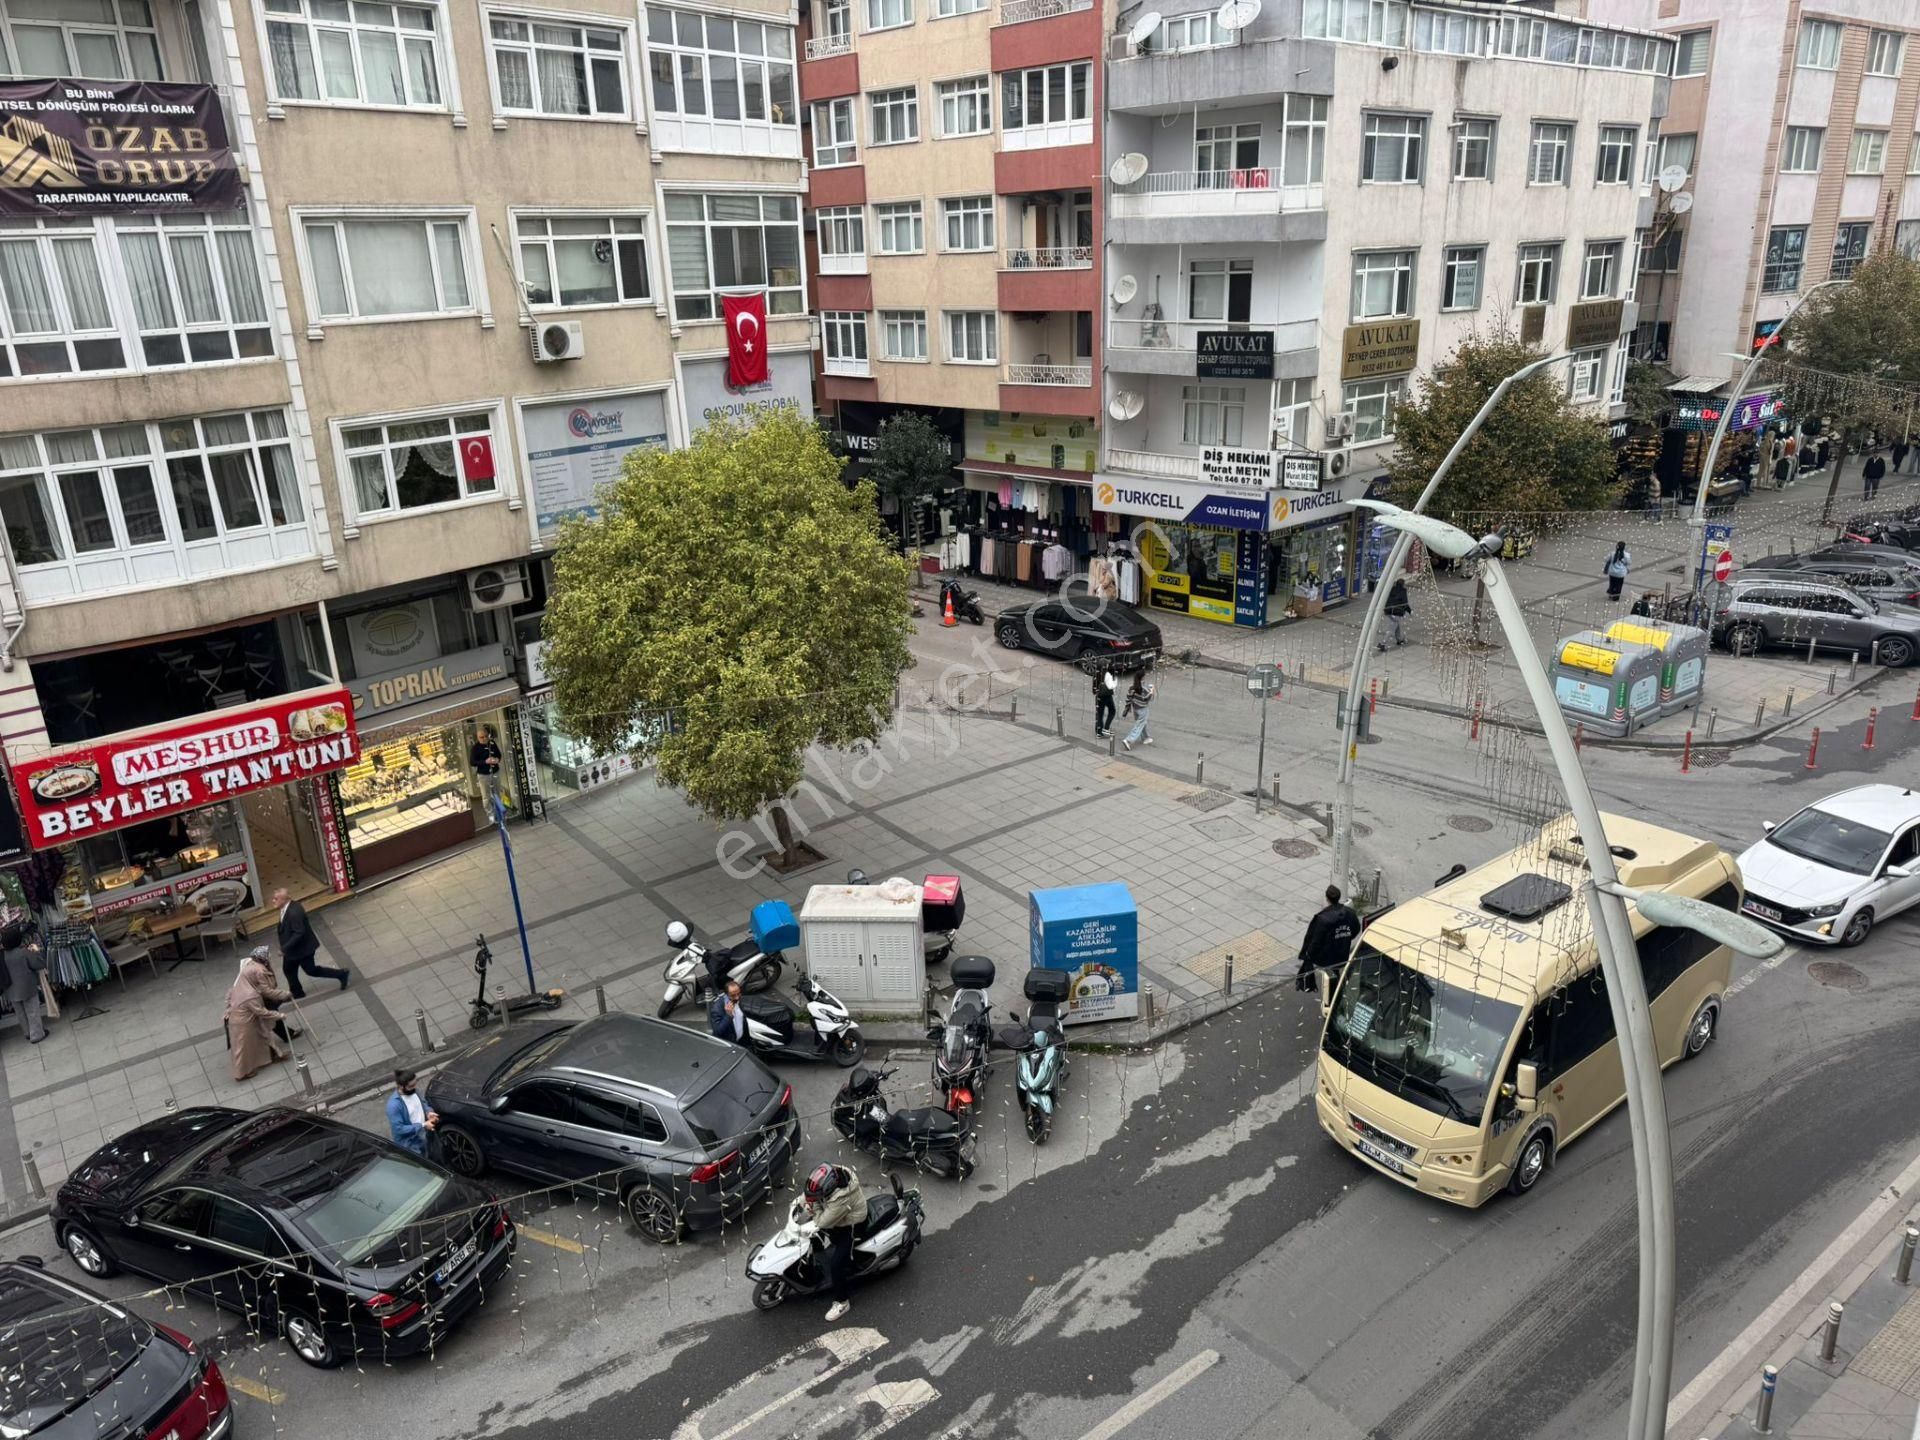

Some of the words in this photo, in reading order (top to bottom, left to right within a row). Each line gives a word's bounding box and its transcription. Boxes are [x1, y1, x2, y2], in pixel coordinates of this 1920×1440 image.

[66, 88, 84, 99] BU
[87, 88, 115, 99] BİNA
[37, 99, 100, 113] DÖNÜŞÜM
[102, 102, 149, 113] PROJESİ
[151, 104, 196, 114] OLARAK
[84, 118, 210, 152] ÖZAB
[95, 159, 216, 185] GRUP
[36, 193, 111, 204] TARAFINDAN
[113, 192, 192, 203] YAPILACAKTIR.
[1203, 335, 1267, 351] AVUKAT
[1357, 324, 1412, 347] AVUKAT
[1204, 448, 1223, 464] DİŞ
[1228, 451, 1270, 465] HEKİMİ
[1203, 463, 1232, 474] Murat
[1236, 465, 1270, 477] METİN
[1225, 475, 1239, 483] 546
[1116, 489, 1185, 510] TURKCELL
[1289, 490, 1343, 514] TURKCELL
[1207, 506, 1228, 516] OZAN
[1229, 505, 1260, 519] İLETİŞİM
[451, 664, 502, 686] KUYUMCULUK
[368, 665, 448, 708] TOPRAK
[530, 692, 555, 707] KAR
[124, 725, 271, 778] MEŞHUR
[38, 779, 192, 838] BEYLER
[202, 734, 356, 794] TANTUNİ
[176, 874, 209, 890] BEYLER
[97, 900, 130, 914] BEYLER
[1082, 919, 1100, 929] GERİ
[1071, 938, 1112, 948] KUMBARASI
